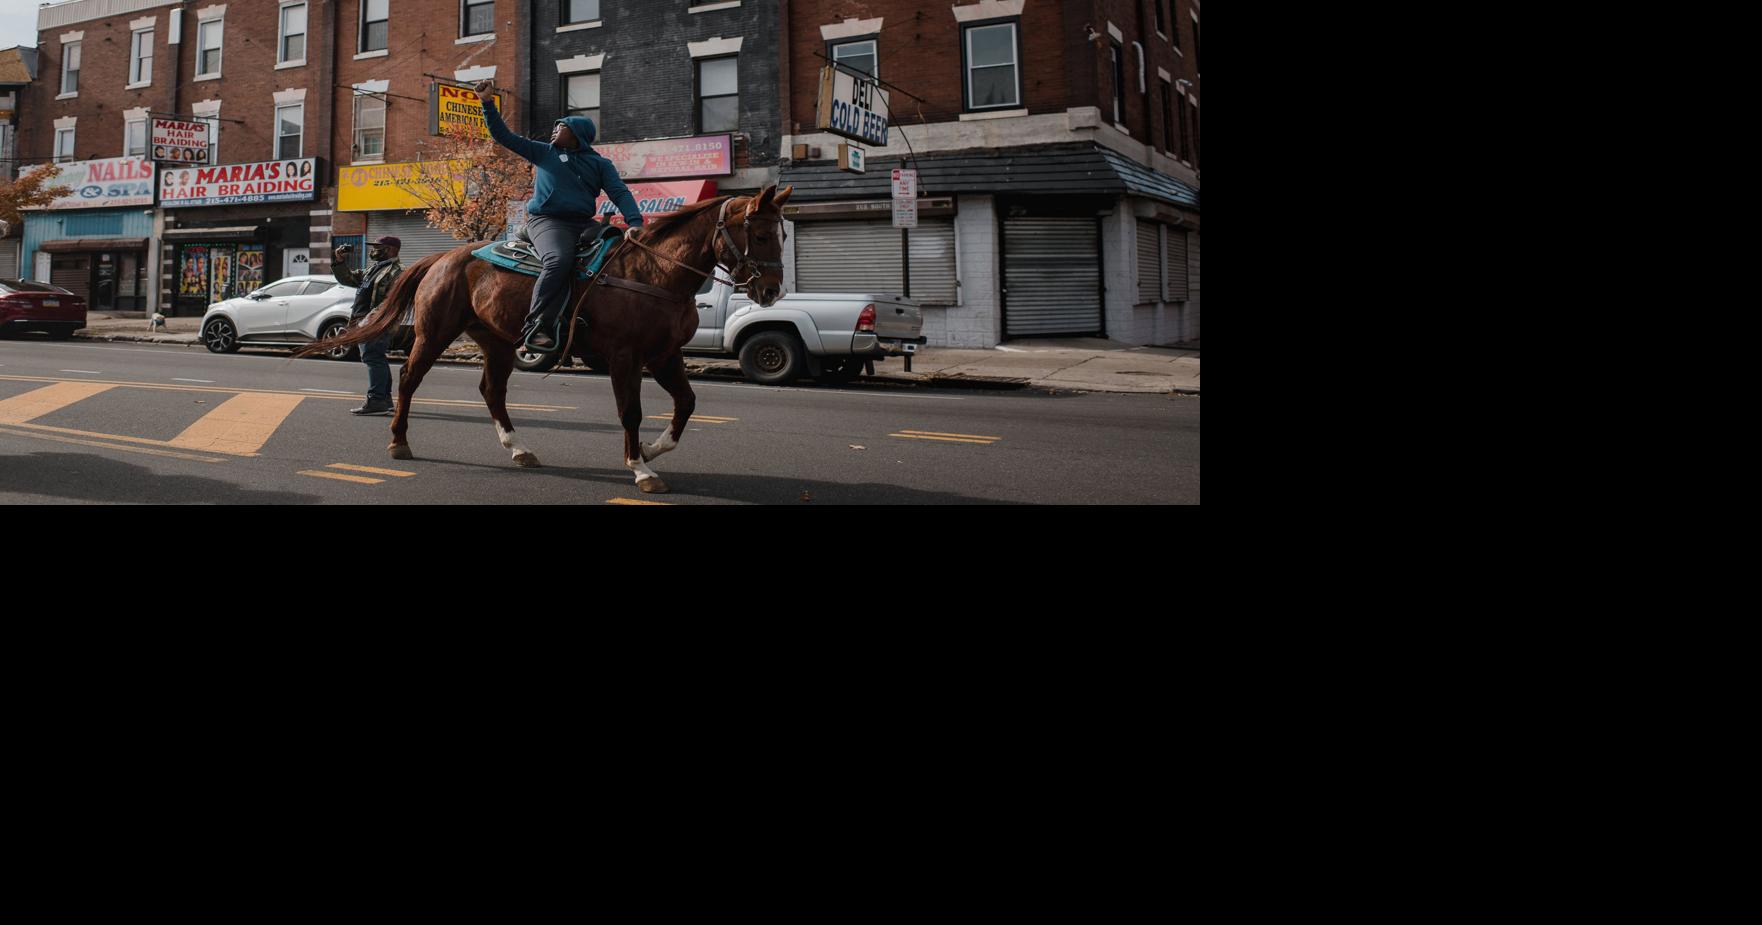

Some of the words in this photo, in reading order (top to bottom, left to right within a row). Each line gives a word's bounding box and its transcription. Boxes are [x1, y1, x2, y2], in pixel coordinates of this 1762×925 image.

[852, 77, 873, 111] DELI
[446, 101, 484, 117] CHINESE
[155, 120, 206, 132] MARIA'S
[440, 112, 479, 127] AMERICAN
[831, 99, 860, 134] COLD
[863, 111, 889, 145] BEER
[167, 130, 194, 138] HAIR
[153, 137, 207, 148] BRAIDING
[88, 159, 153, 182] NAILS
[195, 162, 281, 185] MARIA'S
[107, 182, 152, 197] SPA
[162, 186, 207, 199] HAIR
[217, 178, 313, 196] BRAIDING
[206, 194, 265, 205] 215-471-4885
[638, 196, 687, 213] SALON
